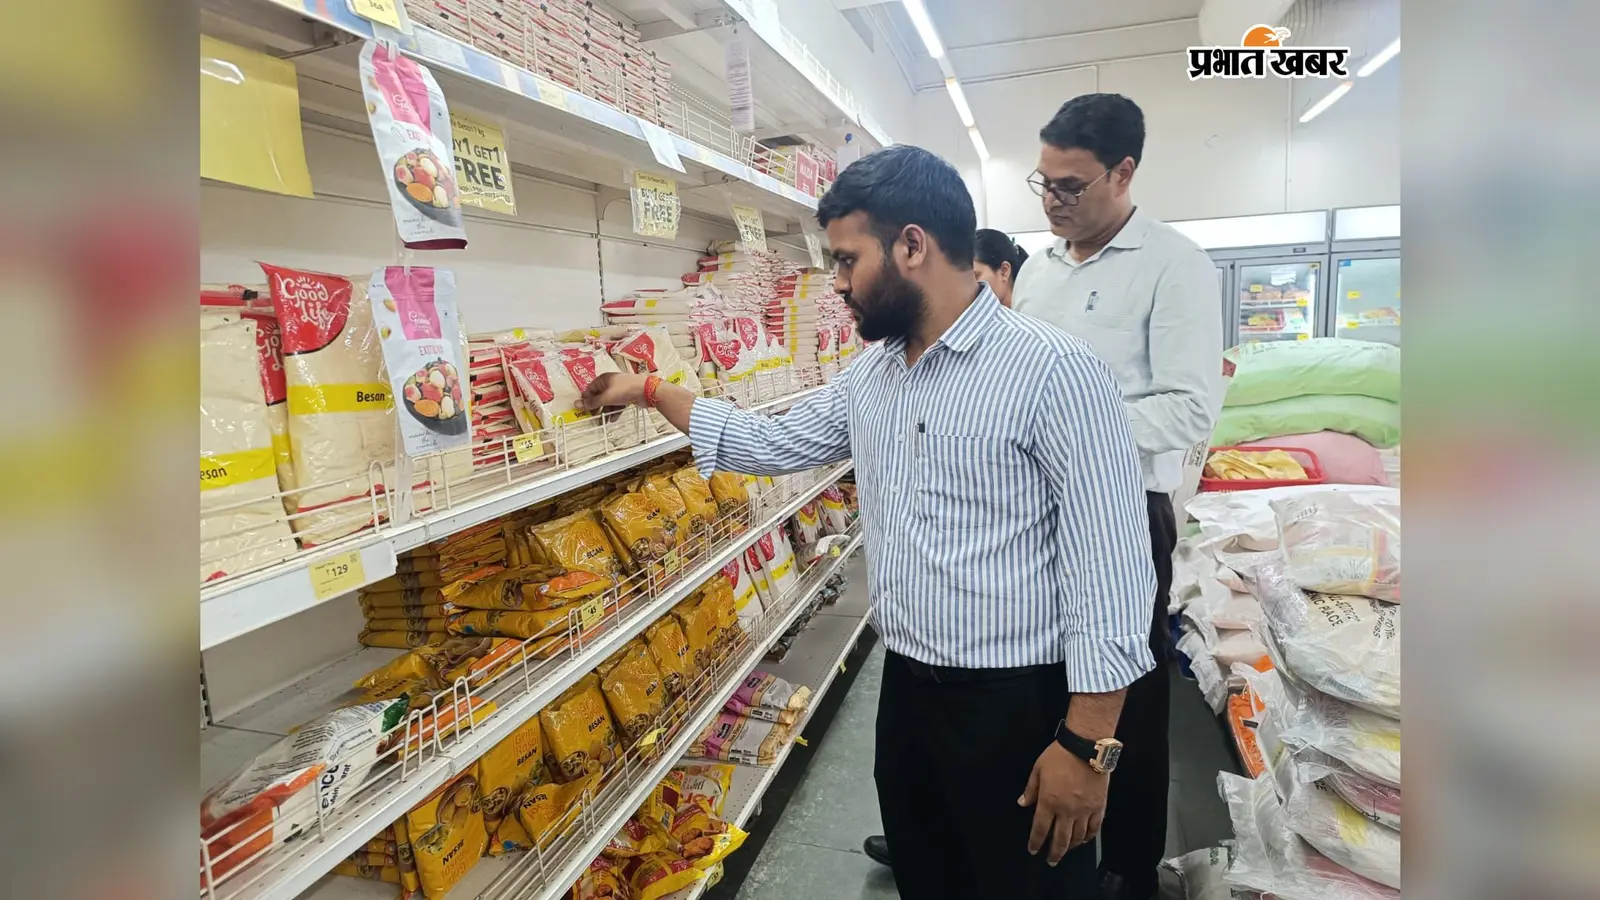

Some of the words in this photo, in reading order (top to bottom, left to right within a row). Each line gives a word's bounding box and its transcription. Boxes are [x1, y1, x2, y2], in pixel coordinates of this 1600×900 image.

[281, 278, 329, 308] Good
[300, 300, 331, 330] Life
[356, 391, 385, 403] Besan
[200, 467, 228, 480] esan
[1318, 605, 1344, 627] PLACE
[588, 714, 606, 733] BESAN
[516, 746, 537, 767] BESAN
[442, 838, 465, 866] BESAN
